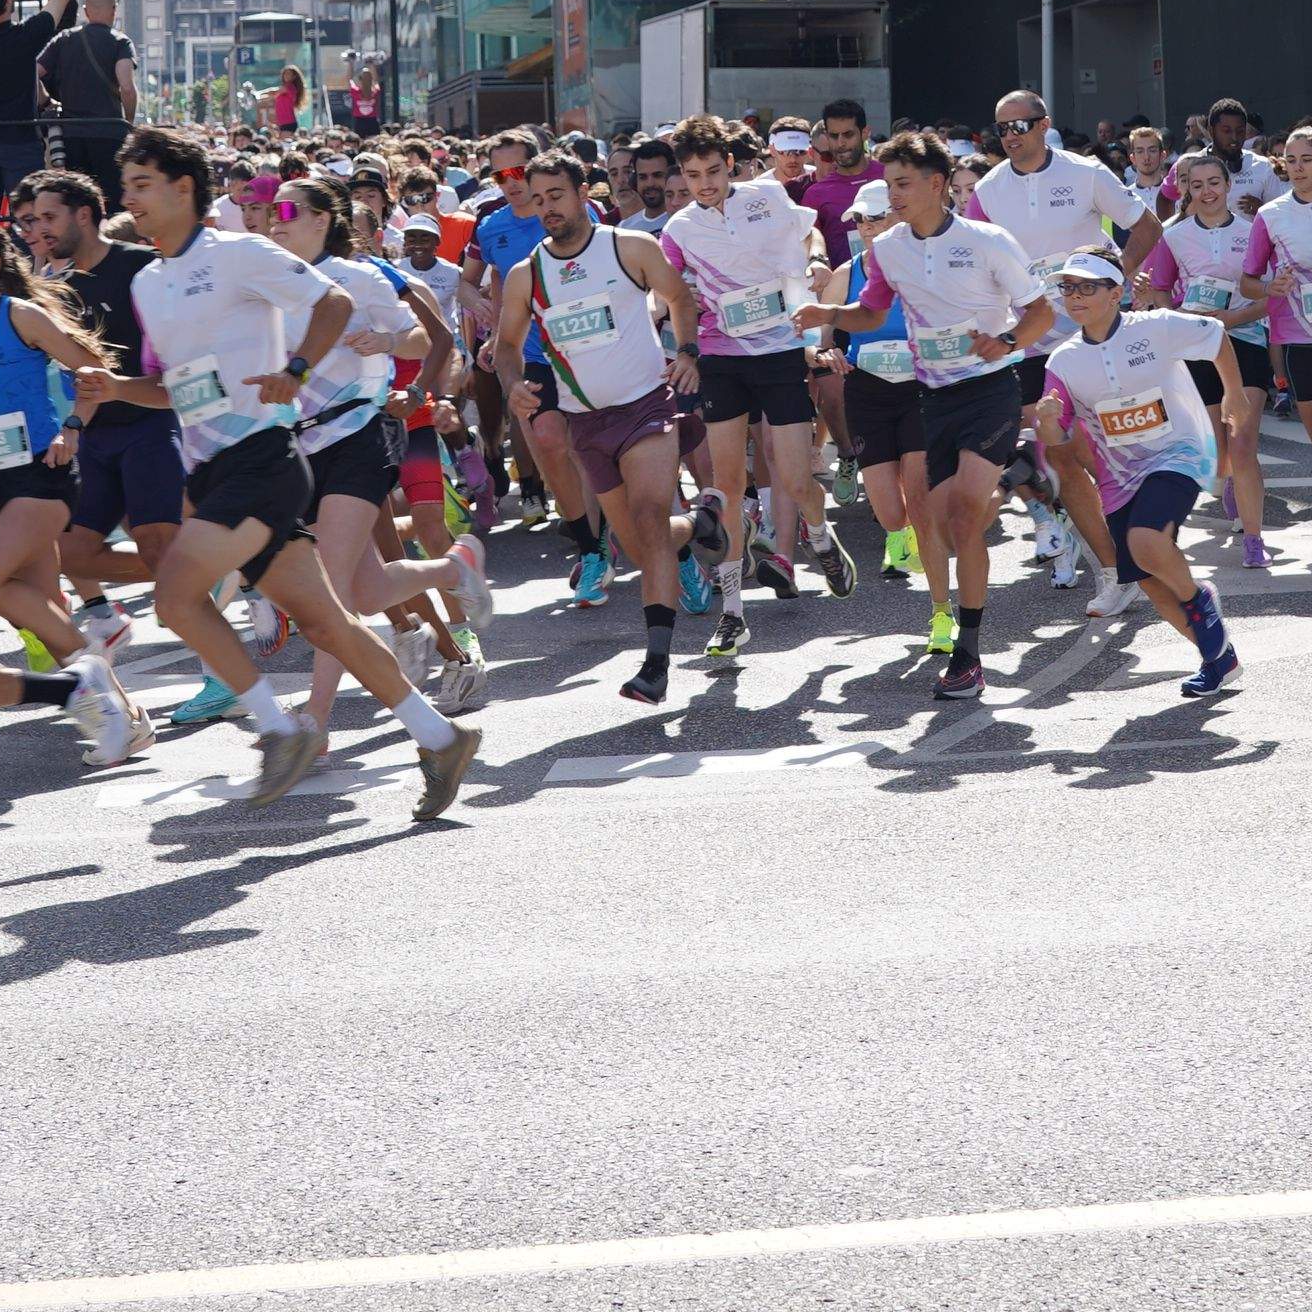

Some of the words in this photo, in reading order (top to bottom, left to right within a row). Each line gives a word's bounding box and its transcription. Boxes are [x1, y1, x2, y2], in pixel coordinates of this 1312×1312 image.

[1050, 198, 1075, 208] MOU-TE
[743, 297, 768, 314] 352
[745, 309, 770, 322] DAVID
[558, 311, 602, 337] 1217
[881, 353, 899, 365] 17
[1128, 352, 1156, 368] MOU-TE
[1111, 406, 1158, 431] 1664
